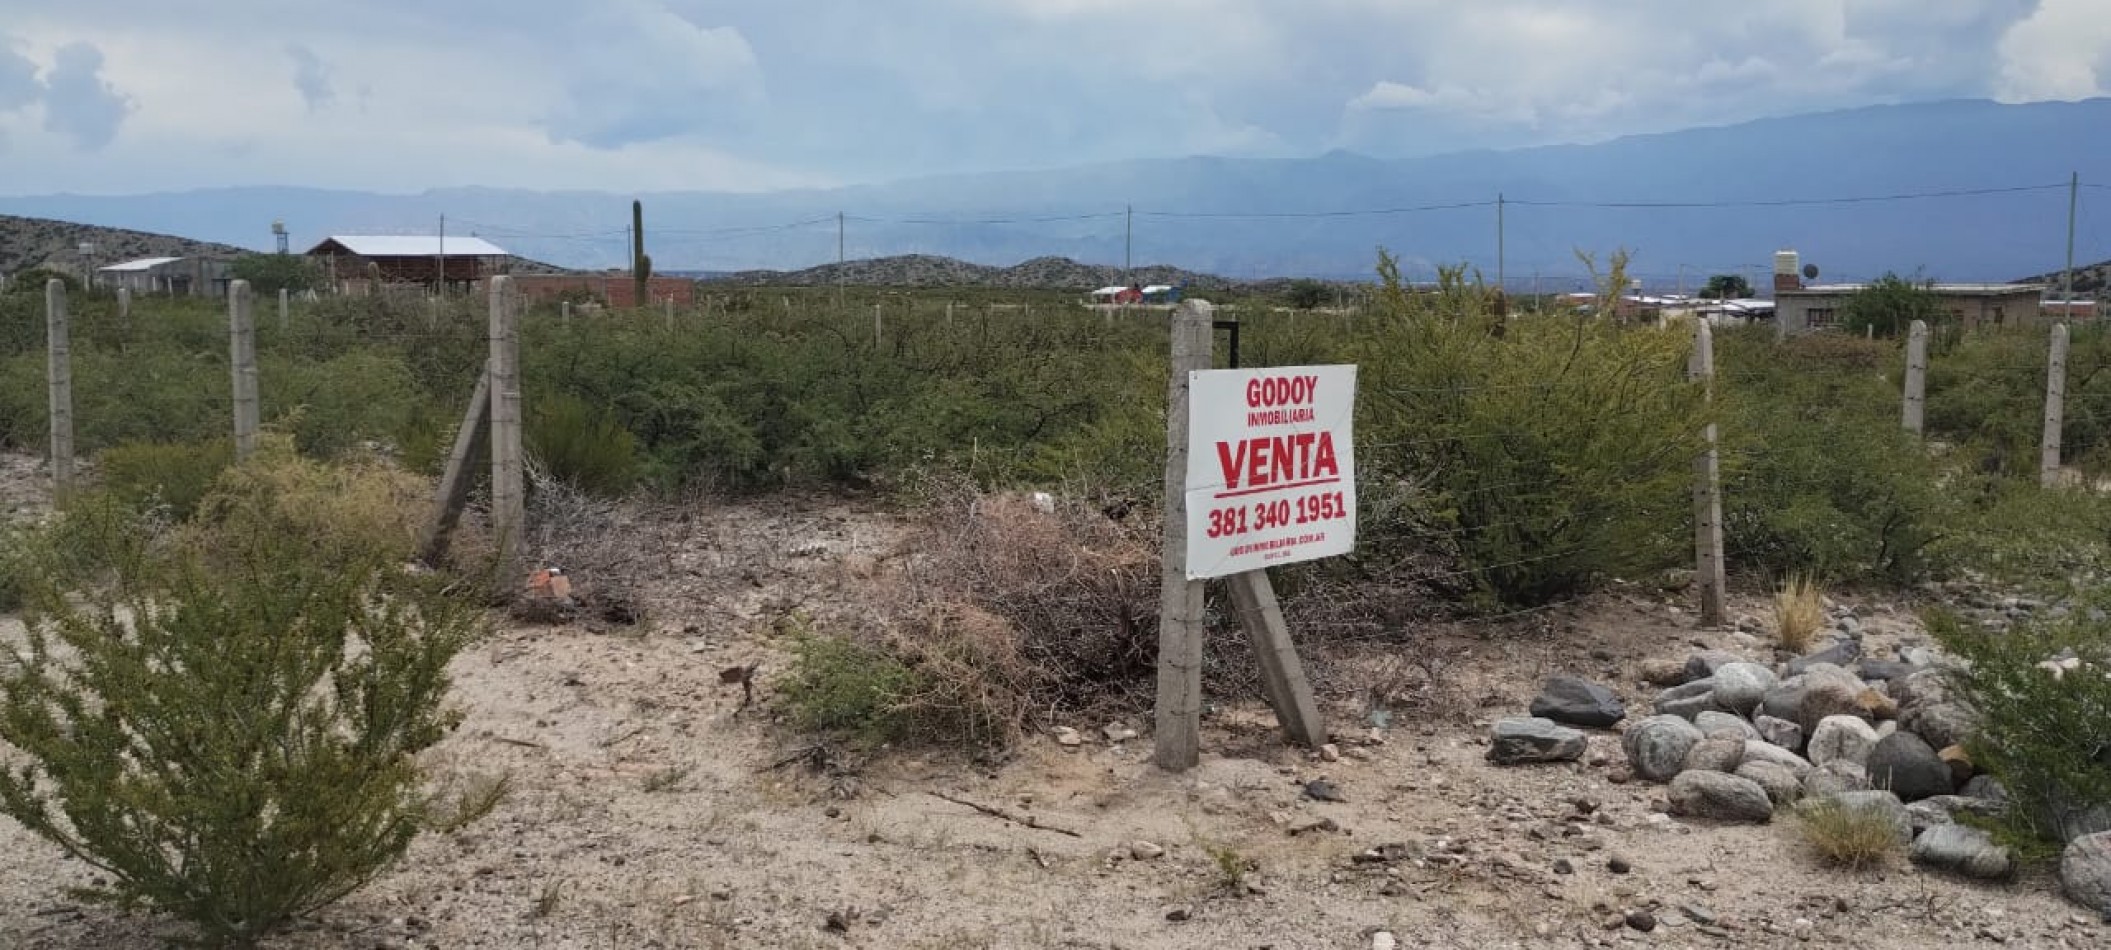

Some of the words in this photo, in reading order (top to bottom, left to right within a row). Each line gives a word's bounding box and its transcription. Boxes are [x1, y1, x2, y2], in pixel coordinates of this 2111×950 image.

[1246, 376, 1318, 408] GODOY
[1247, 408, 1314, 427] INMOBILIARIA
[1216, 431, 1339, 489] VENTA
[1207, 506, 1248, 538] 381
[1254, 499, 1290, 531] 340
[1296, 491, 1346, 524] 1951
